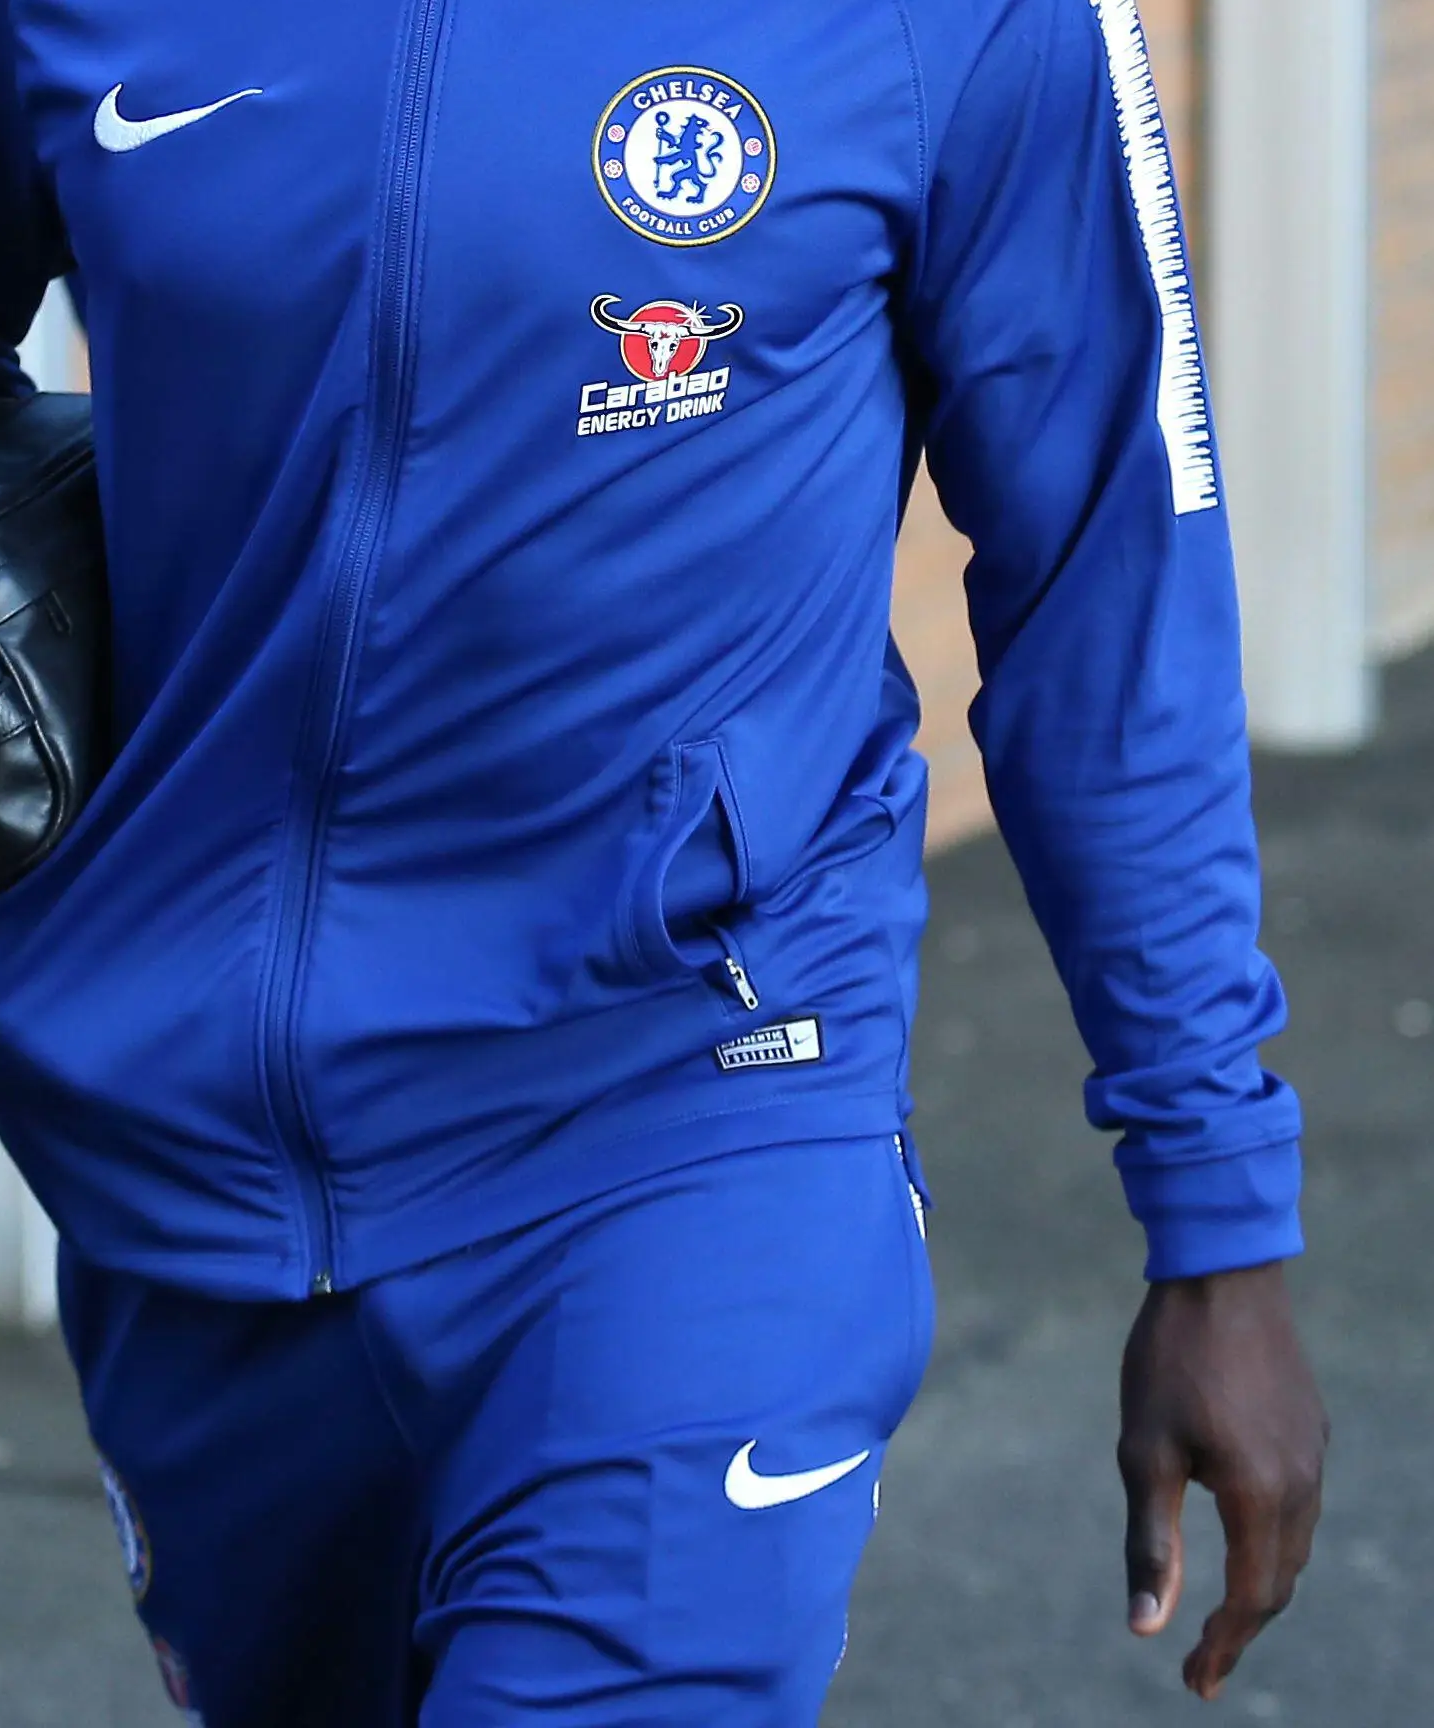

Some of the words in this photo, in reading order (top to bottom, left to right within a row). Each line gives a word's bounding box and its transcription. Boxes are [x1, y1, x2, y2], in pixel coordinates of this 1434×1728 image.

[633, 80, 743, 121] CHELSEA
[622, 197, 693, 235] FOOTBALL
[698, 207, 736, 233] CLUB
[579, 367, 731, 414] Carabao
[577, 405, 662, 436] ENERGY
[666, 392, 726, 423] DRINK
